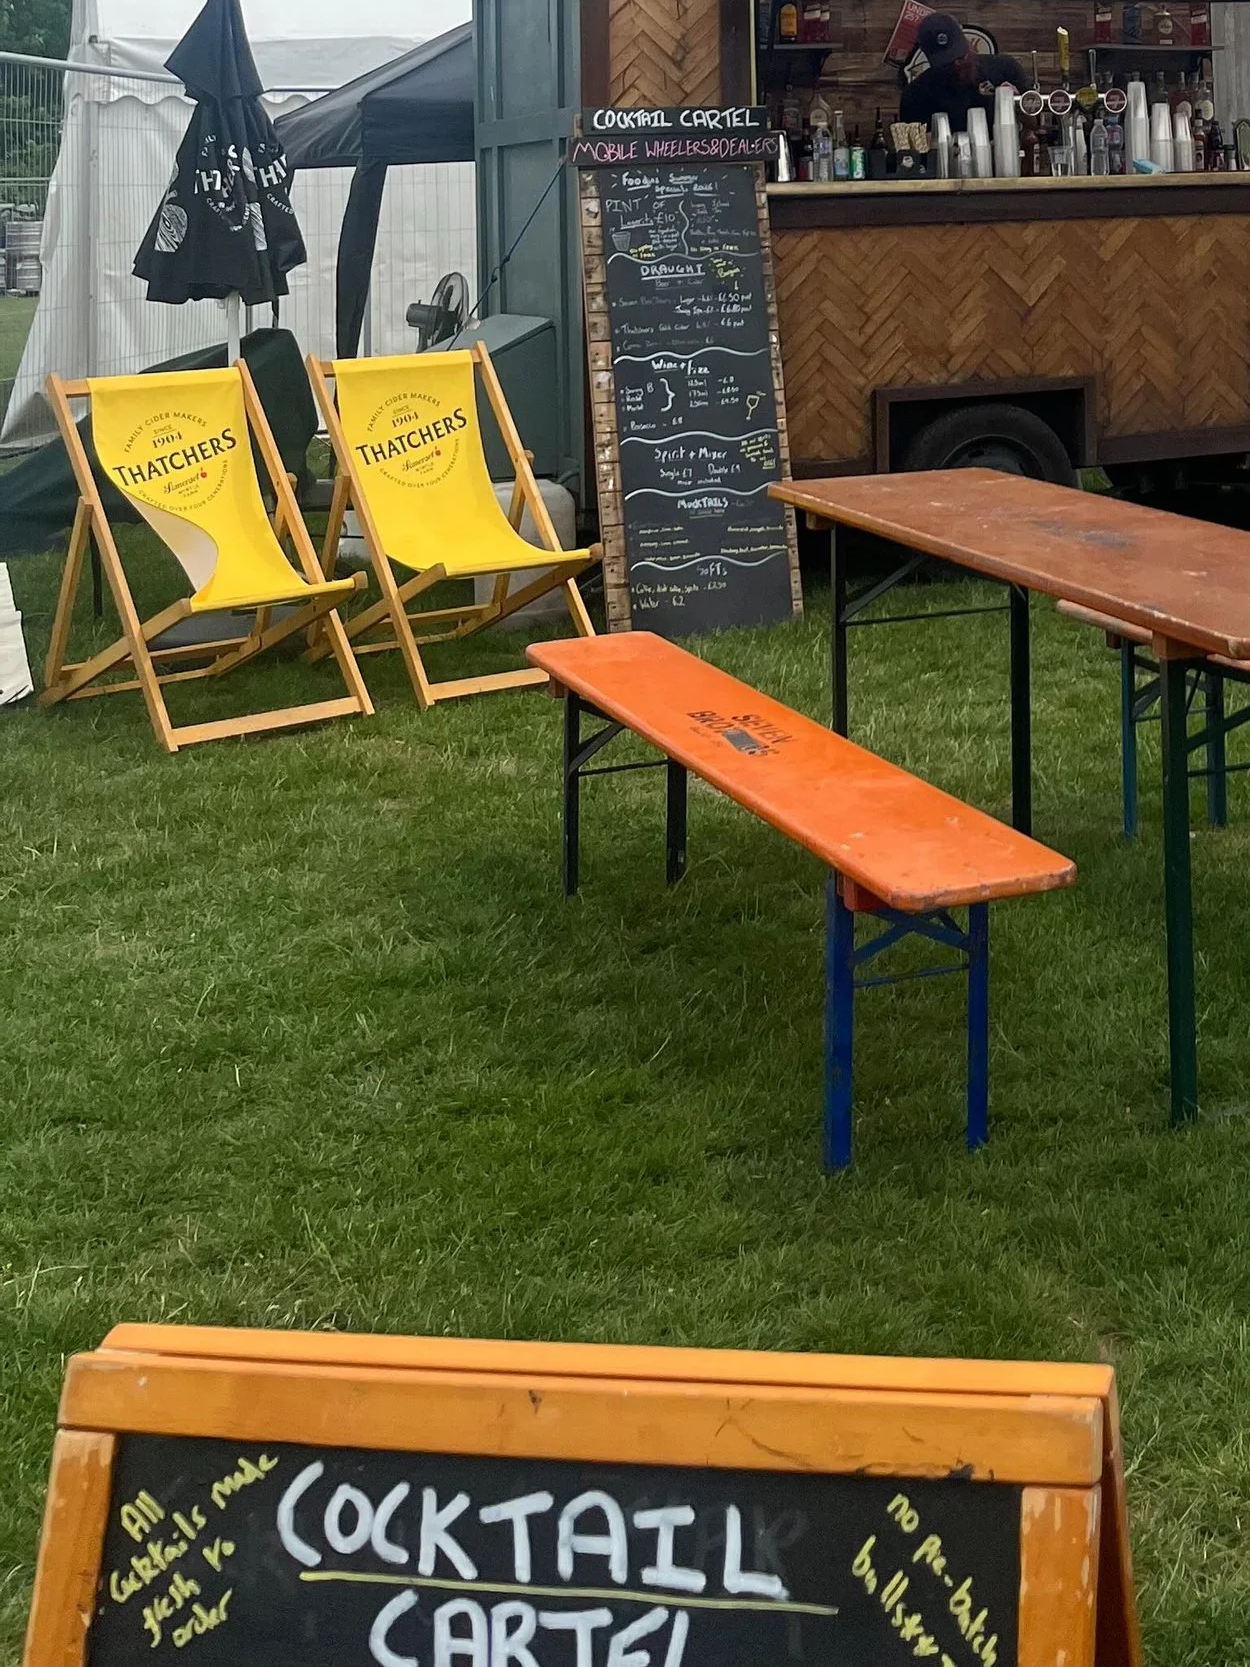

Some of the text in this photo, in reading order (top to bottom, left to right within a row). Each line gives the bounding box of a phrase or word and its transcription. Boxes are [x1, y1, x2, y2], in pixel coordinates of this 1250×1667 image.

[593, 107, 760, 130] COCKTAIL CARTEL
[572, 140, 638, 163] MOBILE
[605, 198, 641, 213] PINT
[641, 264, 703, 277] DRAUGHT
[367, 392, 441, 432] FAMILY CIDER MAKERS
[392, 411, 419, 429] 1904
[124, 412, 208, 453] FAMILY CIDER MAKERS
[151, 431, 183, 449] 1904
[153, 424, 173, 434] SINCE
[356, 408, 467, 466] THATCHERS
[112, 427, 237, 486] THATCHERS
[120, 1488, 166, 1543] All
[886, 1492, 920, 1534] no
[276, 1459, 791, 1600] COCKTAIL
